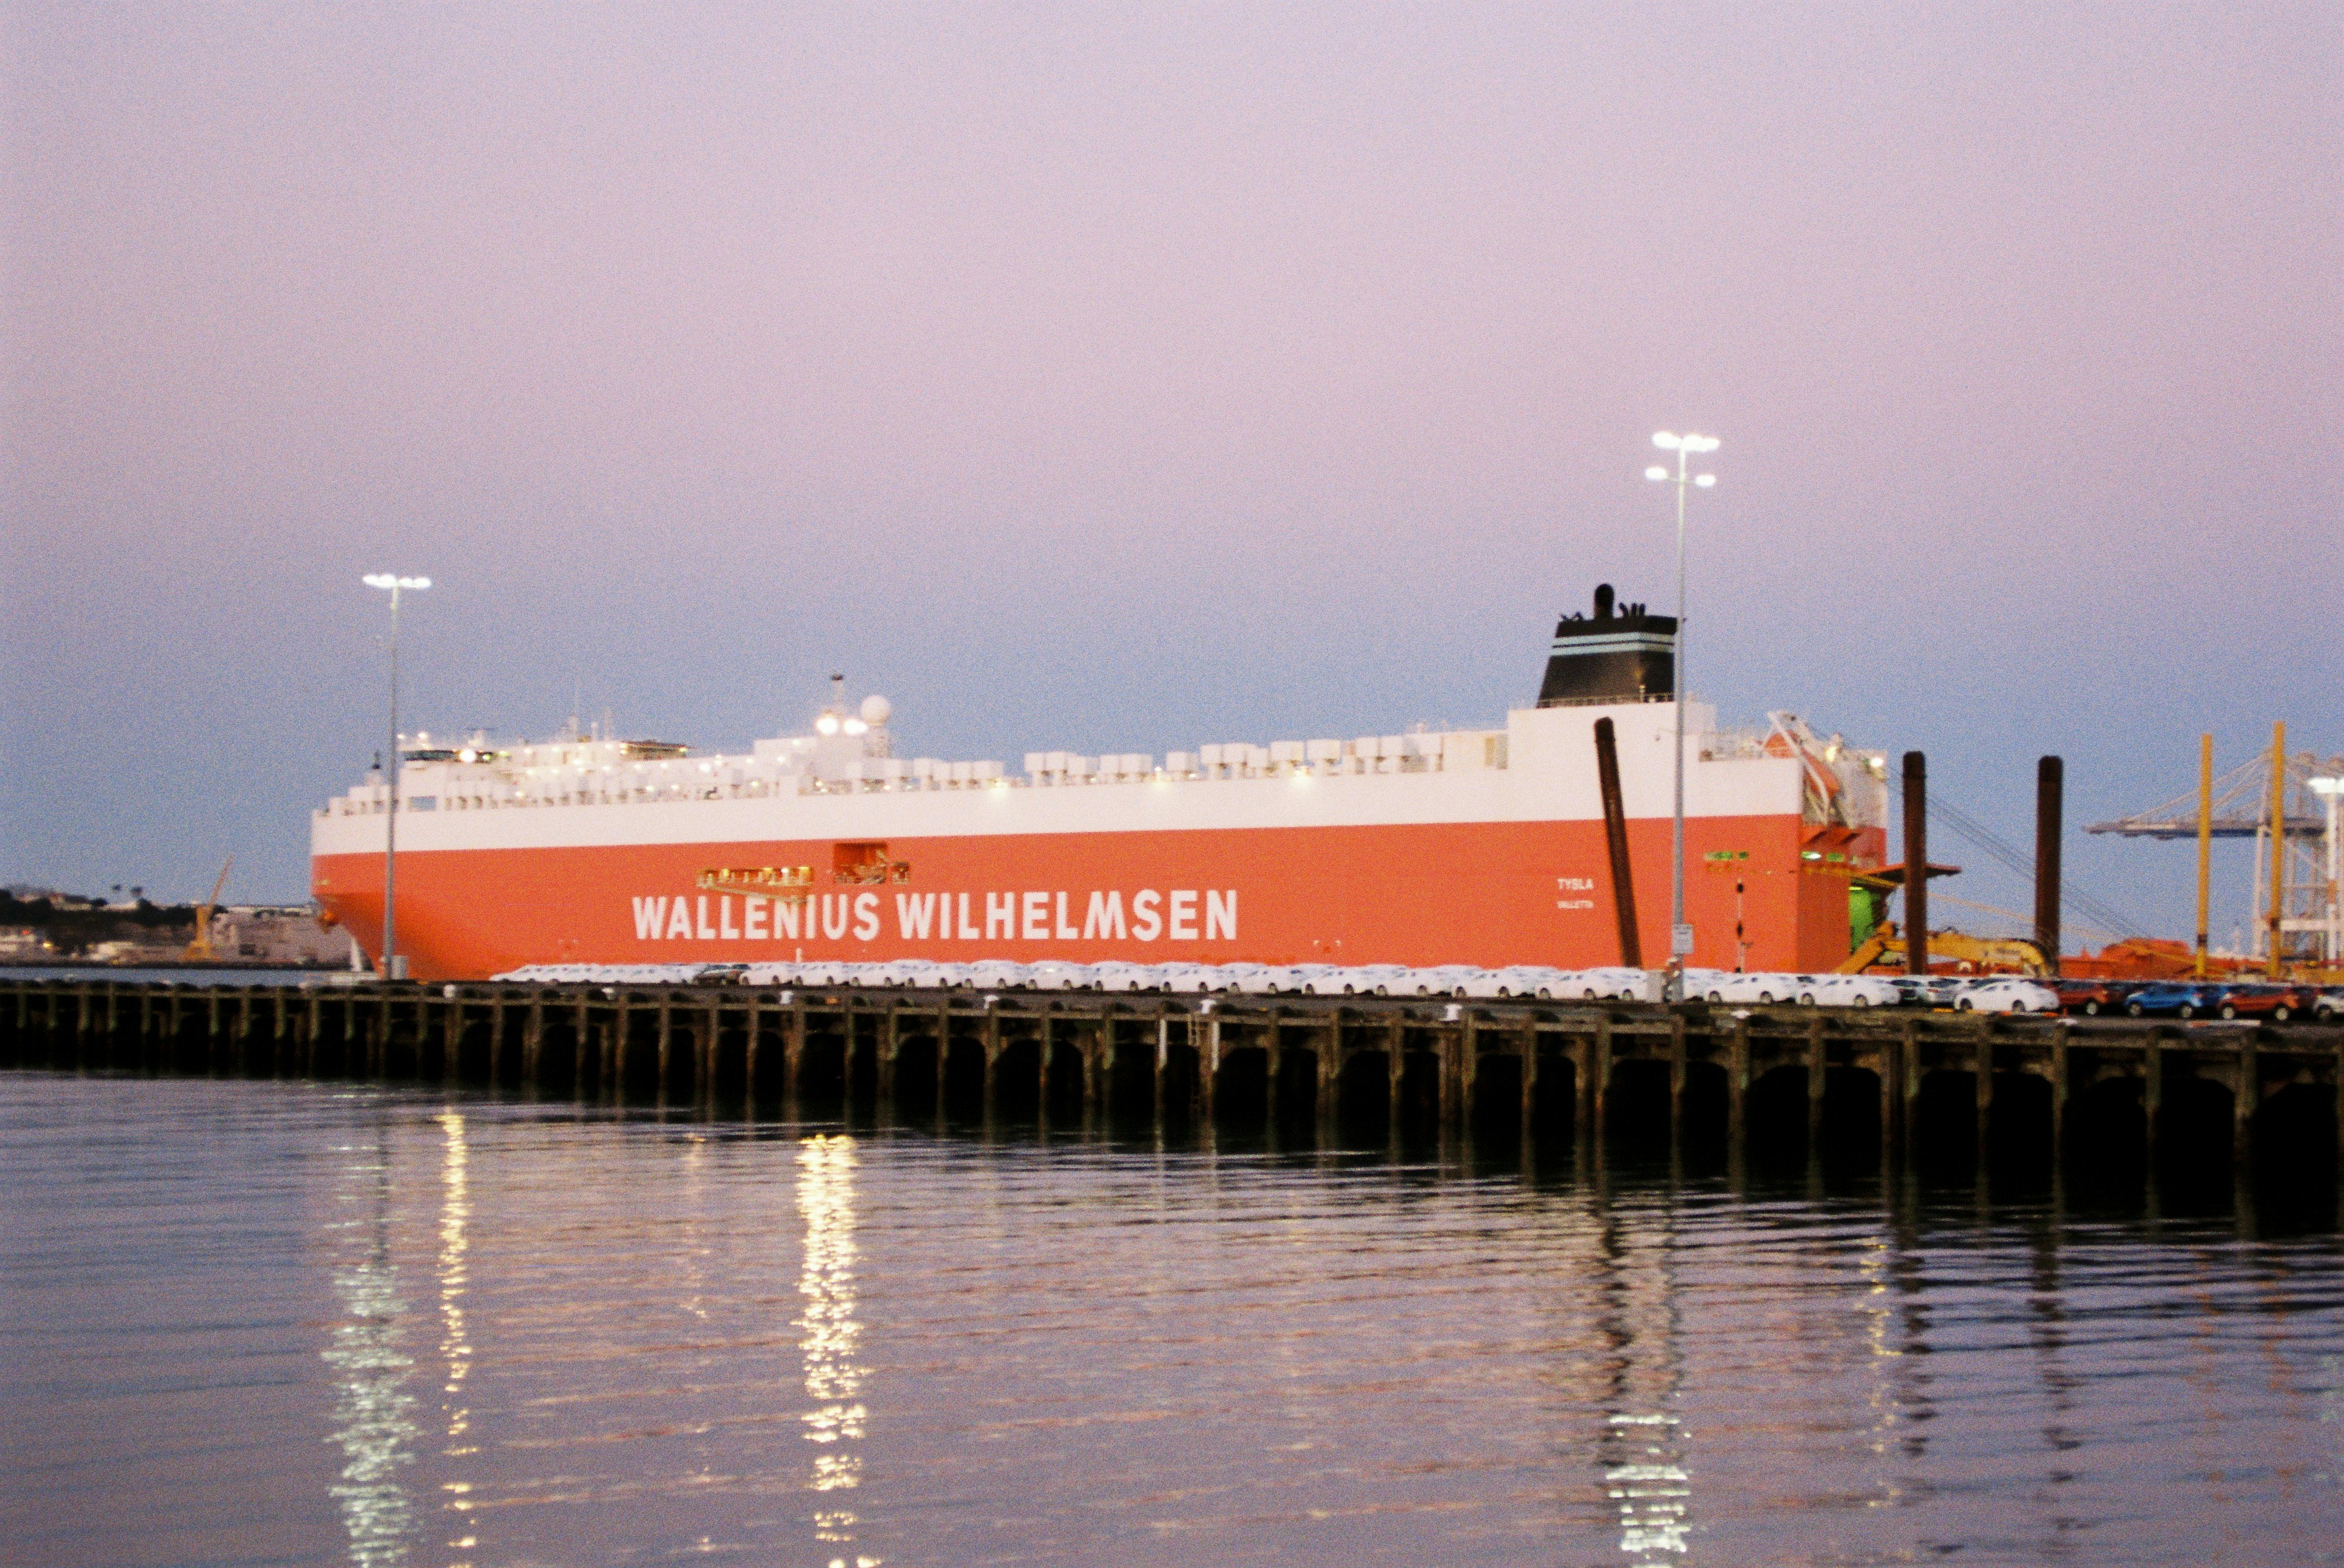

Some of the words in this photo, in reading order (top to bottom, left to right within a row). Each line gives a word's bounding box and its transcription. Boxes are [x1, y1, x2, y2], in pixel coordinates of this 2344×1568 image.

[1557, 878, 1594, 890] TYSLA
[632, 893, 880, 941] WALLENIUS
[896, 889, 1238, 941] WILHELMSEN
